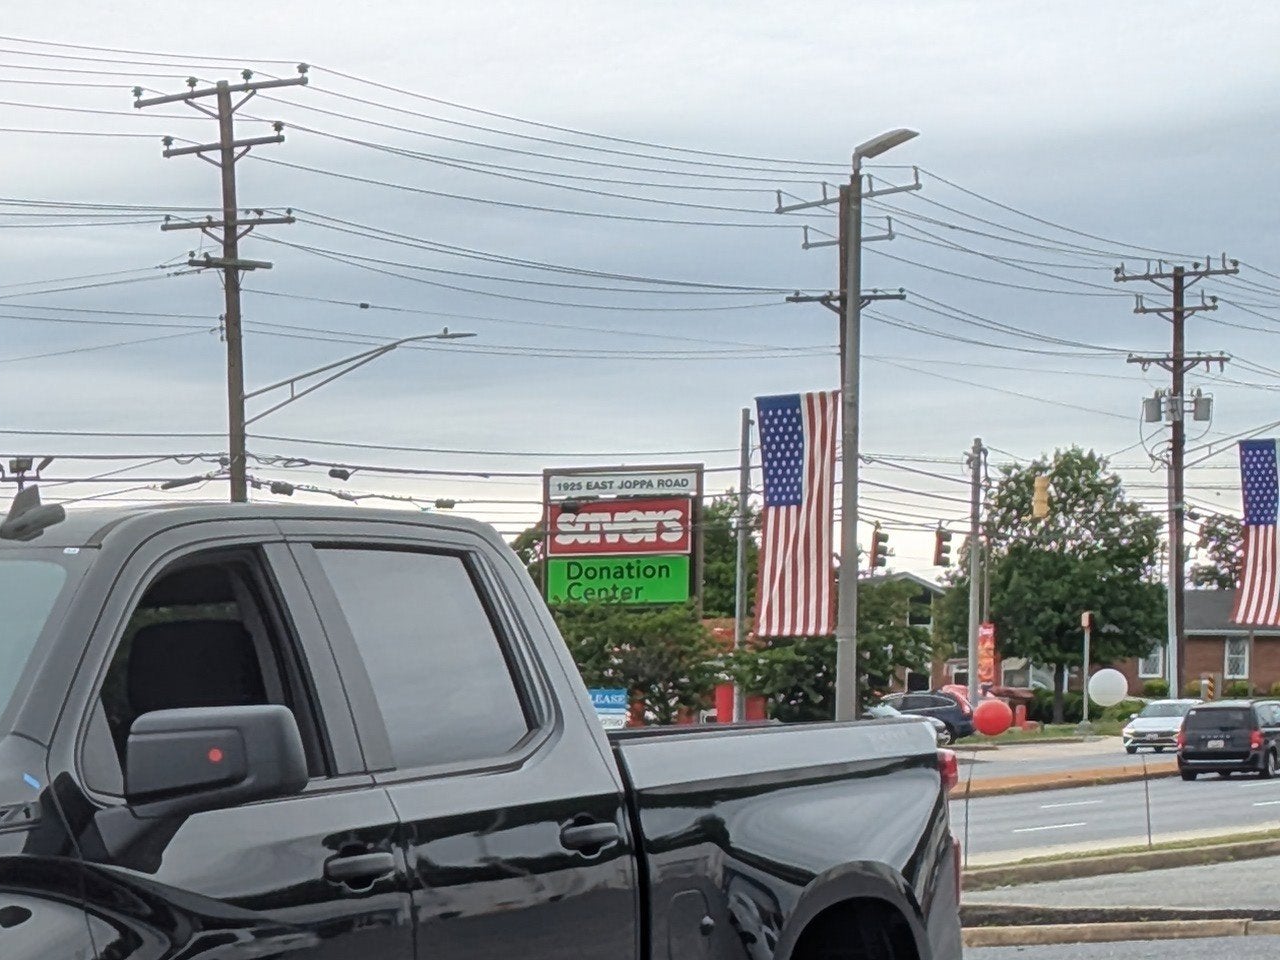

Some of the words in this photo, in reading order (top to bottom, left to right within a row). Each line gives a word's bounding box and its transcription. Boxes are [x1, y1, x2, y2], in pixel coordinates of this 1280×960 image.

[557, 481, 582, 491] 1925
[586, 480, 614, 490] EAST
[619, 479, 654, 489] JOPPA
[657, 478, 689, 488] ROAD
[566, 560, 670, 581] Donation
[566, 582, 644, 601] Center
